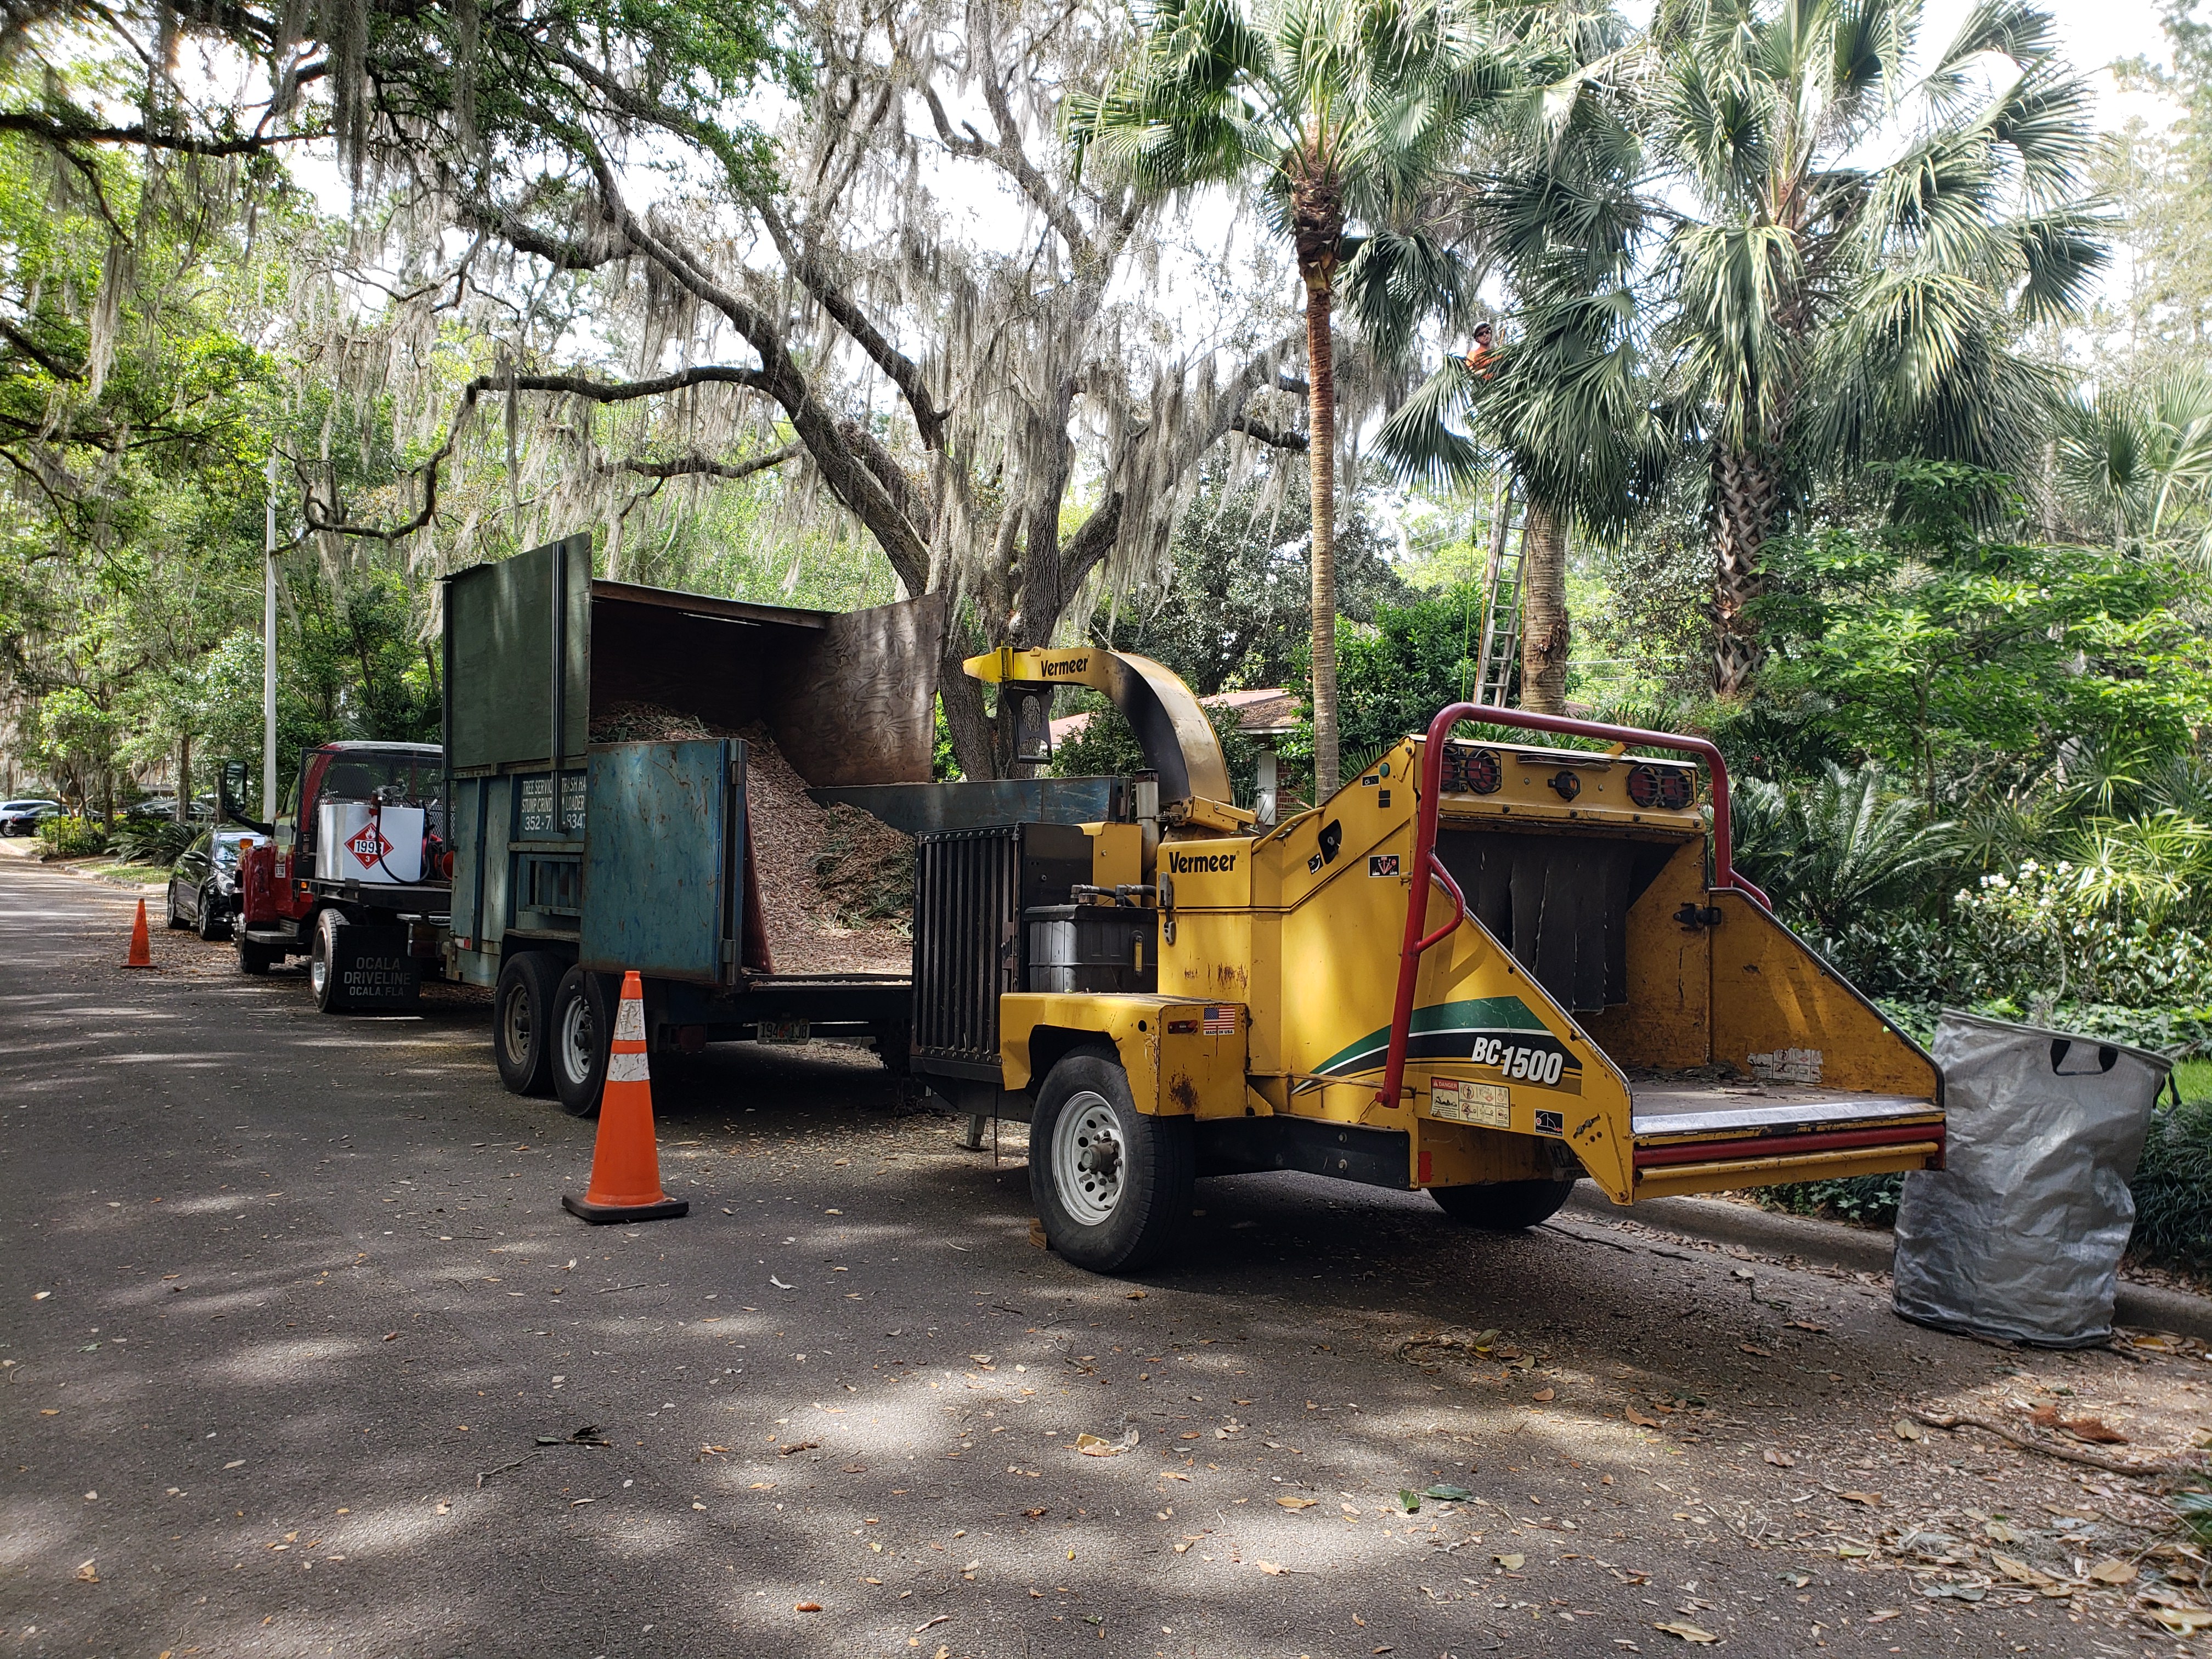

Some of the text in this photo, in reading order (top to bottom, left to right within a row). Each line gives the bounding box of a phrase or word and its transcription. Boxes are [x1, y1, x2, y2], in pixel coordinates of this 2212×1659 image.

[1041, 658, 1088, 677] Vermeer
[523, 775, 586, 795] TREE SERVIC TRASH HA
[522, 795, 584, 813] STUMP GRIND LOADER
[1169, 851, 1236, 873] Vermeer
[356, 957, 400, 970] OCALA
[344, 972, 411, 985] DRIVELINE
[761, 1023, 778, 1038] 194
[1471, 1037, 1563, 1084] BC1500
